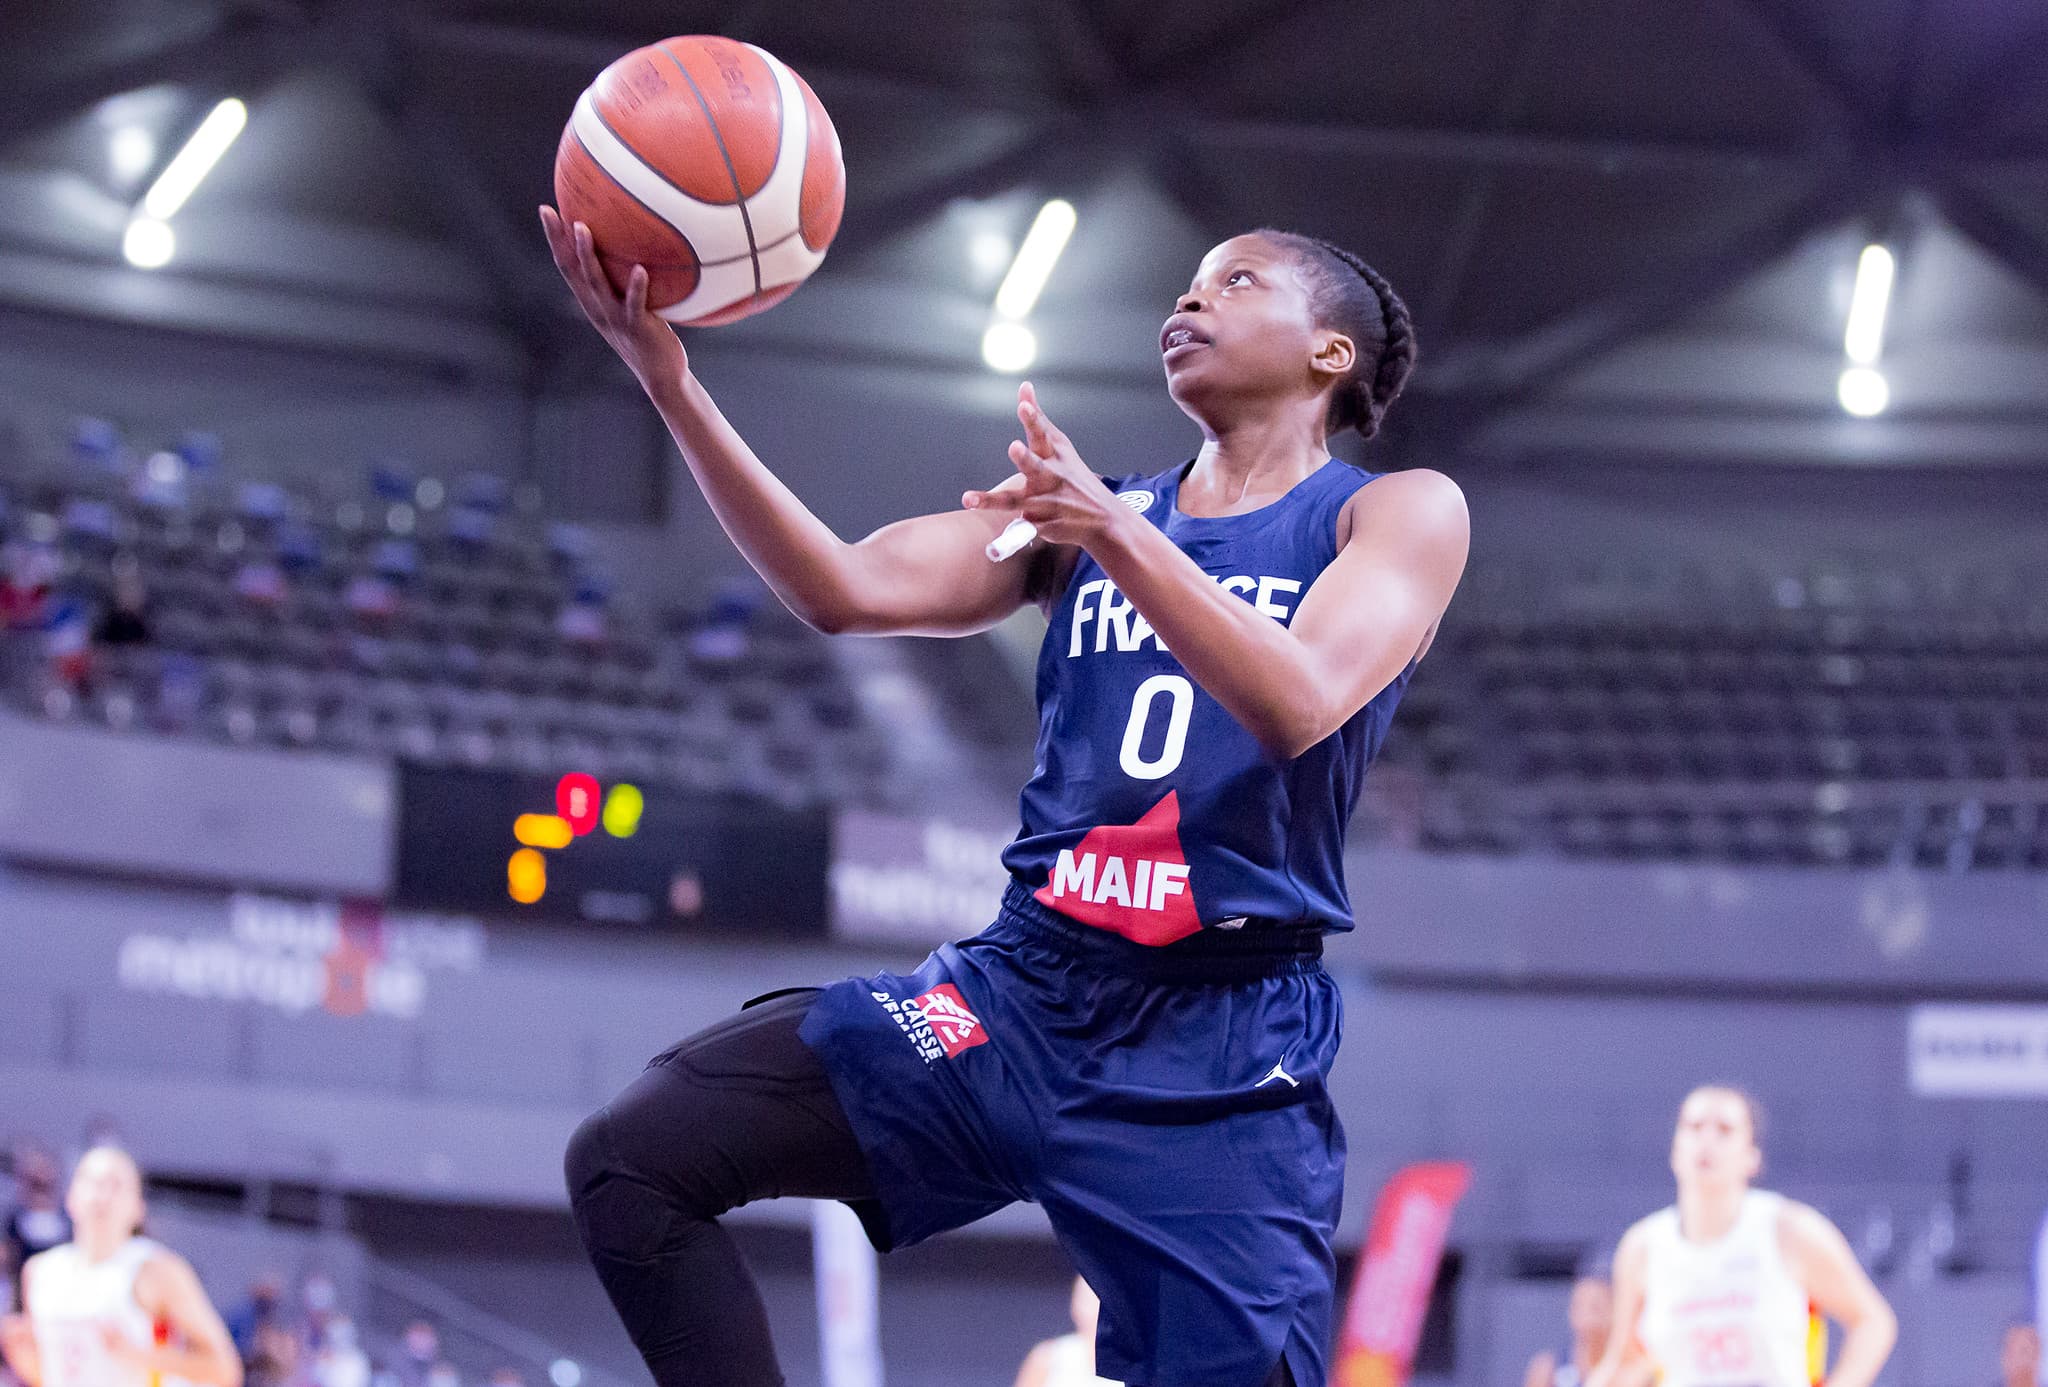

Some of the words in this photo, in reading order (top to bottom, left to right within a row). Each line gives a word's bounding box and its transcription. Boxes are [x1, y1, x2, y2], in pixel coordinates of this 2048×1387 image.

[1067, 576, 1302, 659] FRACE
[1119, 674, 1194, 780] 0
[1053, 849, 1191, 911] MAIF
[900, 998, 944, 1061] CAISSE
